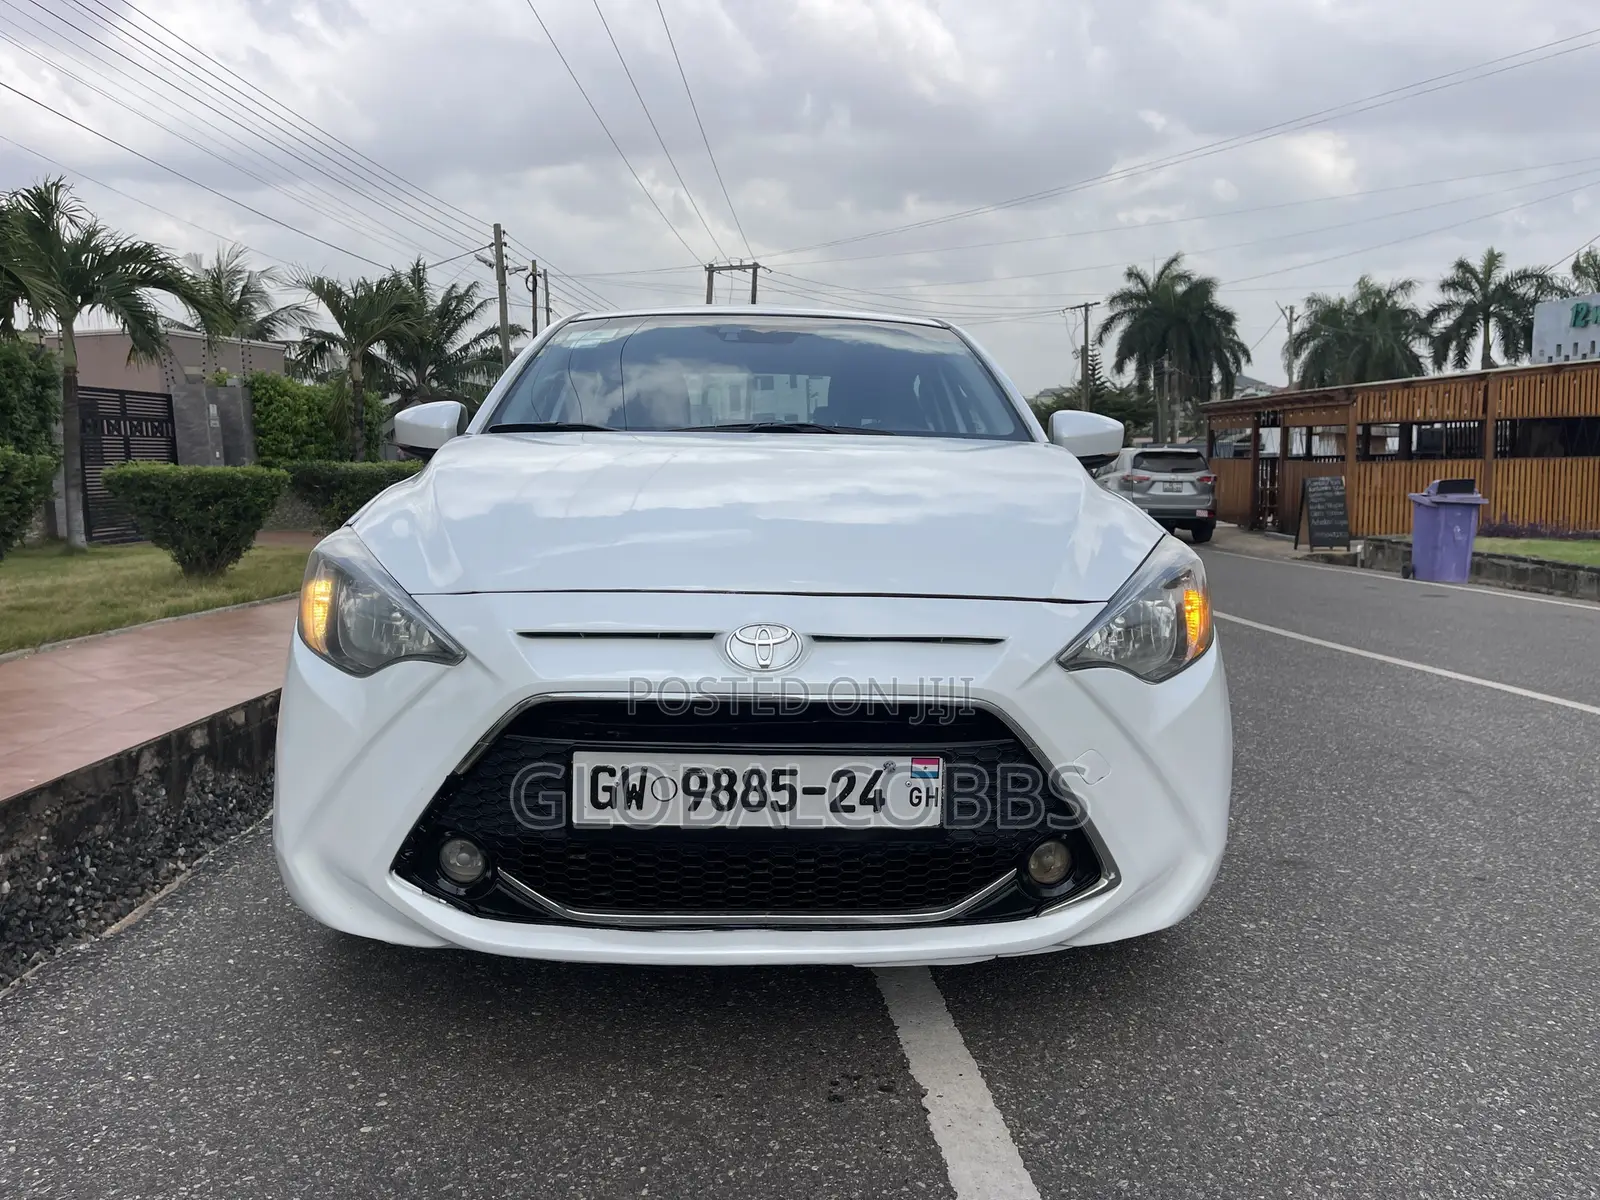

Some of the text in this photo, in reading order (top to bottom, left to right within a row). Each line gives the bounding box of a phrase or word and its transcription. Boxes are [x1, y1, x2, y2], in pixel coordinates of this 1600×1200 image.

[589, 764, 886, 814] GW 9885-24
[909, 786, 939, 808] GH
